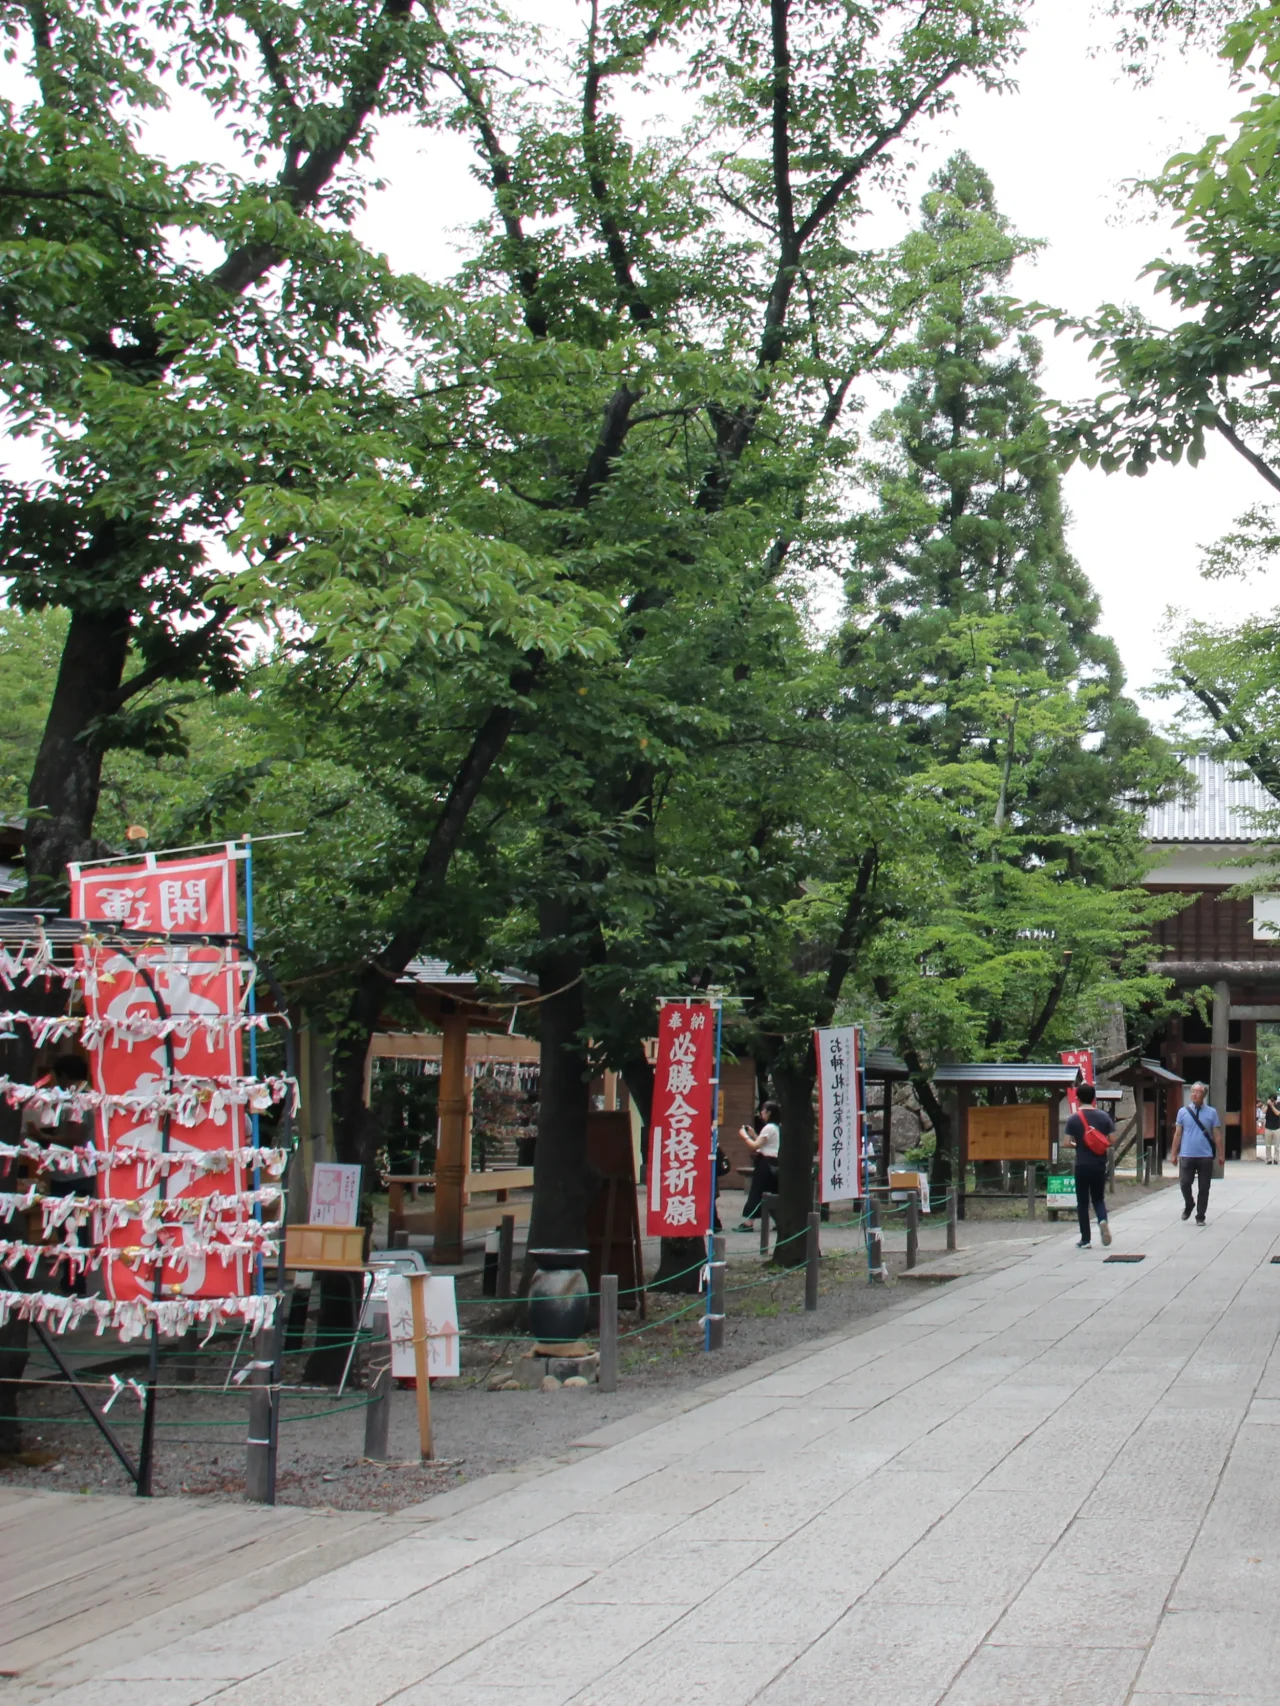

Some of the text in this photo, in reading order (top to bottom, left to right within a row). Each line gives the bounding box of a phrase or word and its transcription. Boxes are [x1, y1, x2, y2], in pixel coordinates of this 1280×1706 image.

[668, 1011, 705, 1032] 奉納
[663, 1031, 699, 1226] 必勝合格祈願
